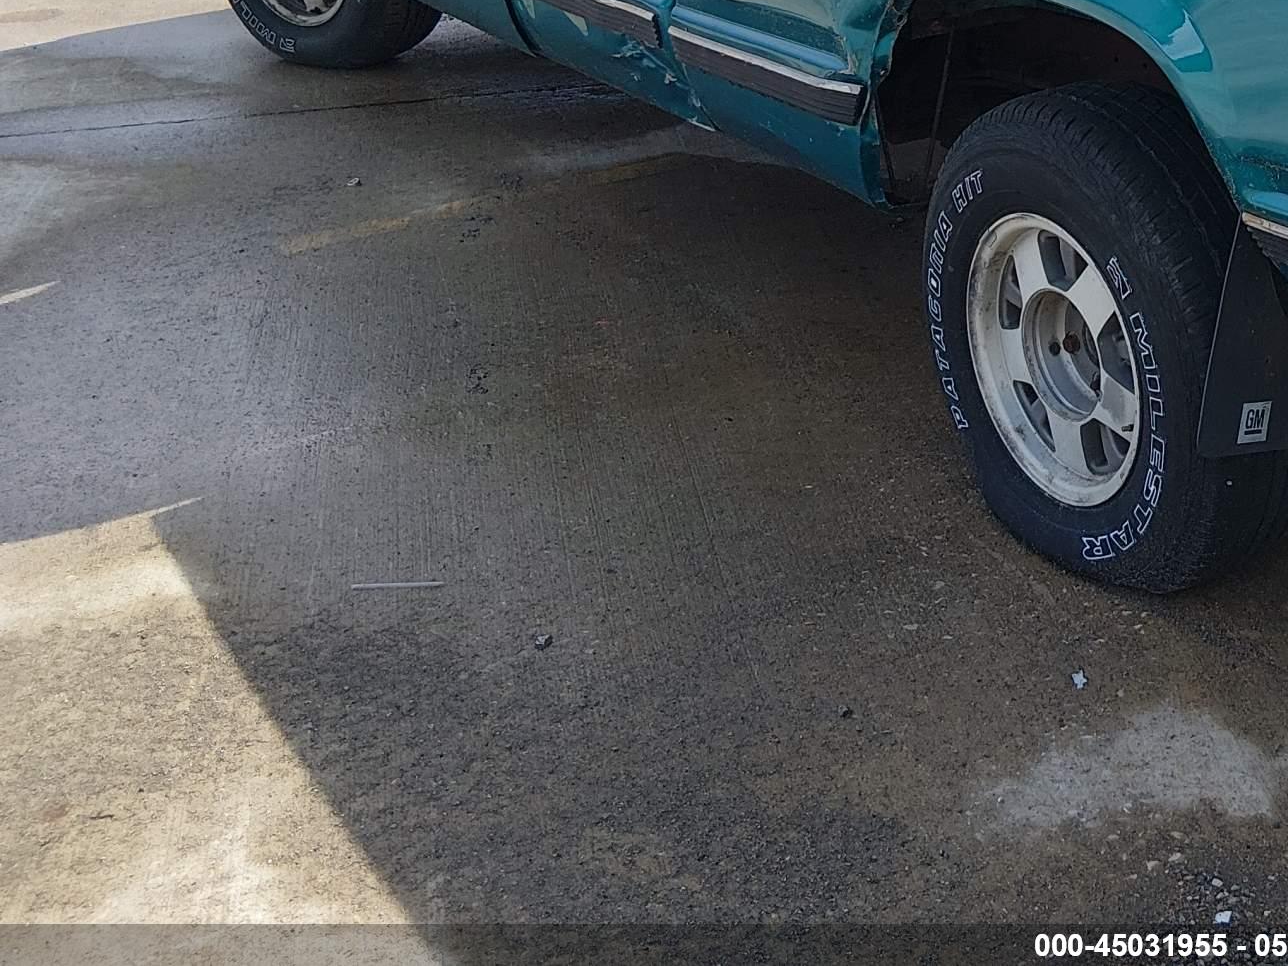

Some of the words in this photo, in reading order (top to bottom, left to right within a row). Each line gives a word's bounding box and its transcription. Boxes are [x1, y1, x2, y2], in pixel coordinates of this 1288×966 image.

[928, 210, 968, 429] PATAGONIA
[1245, 408, 1266, 430] GM
[1082, 313, 1166, 561] MILESTAR
